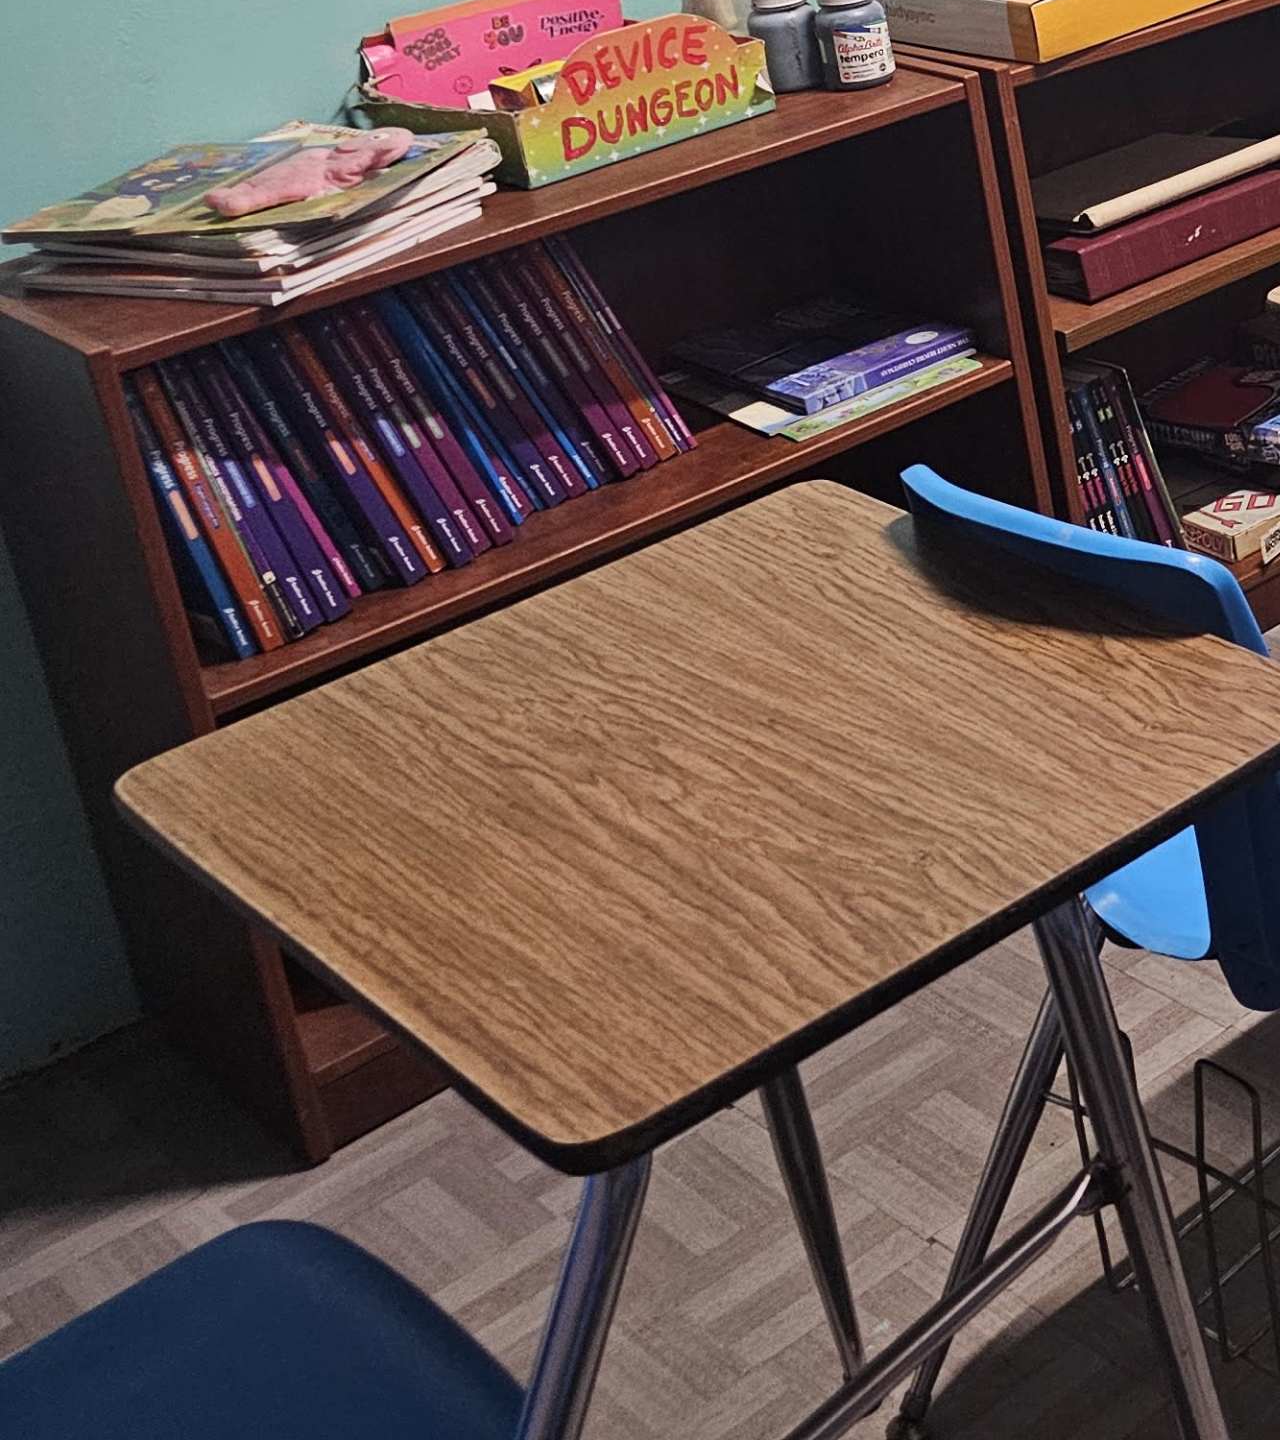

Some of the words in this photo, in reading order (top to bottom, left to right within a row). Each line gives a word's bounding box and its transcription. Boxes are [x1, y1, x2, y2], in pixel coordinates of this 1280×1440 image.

[562, 24, 709, 106] DEVICE
[561, 63, 740, 163] DUNGEON
[518, 302, 542, 336] Progress
[540, 297, 564, 332] Progress
[563, 289, 586, 322] Progress
[464, 324, 487, 359] Progress
[499, 311, 521, 347] Progress
[443, 332, 466, 368] Progress
[352, 374, 376, 411] Progress
[369, 367, 393, 403] Progress
[391, 357, 414, 393] Progress
[264, 400, 290, 438] Progress
[303, 391, 326, 429] Progress
[325, 383, 349, 419] Progress
[203, 418, 228, 456] Progress
[229, 411, 254, 452] Progress
[149, 449, 175, 490] Progress
[172, 439, 196, 481] Progress
[1213, 491, 1276, 513] GO
